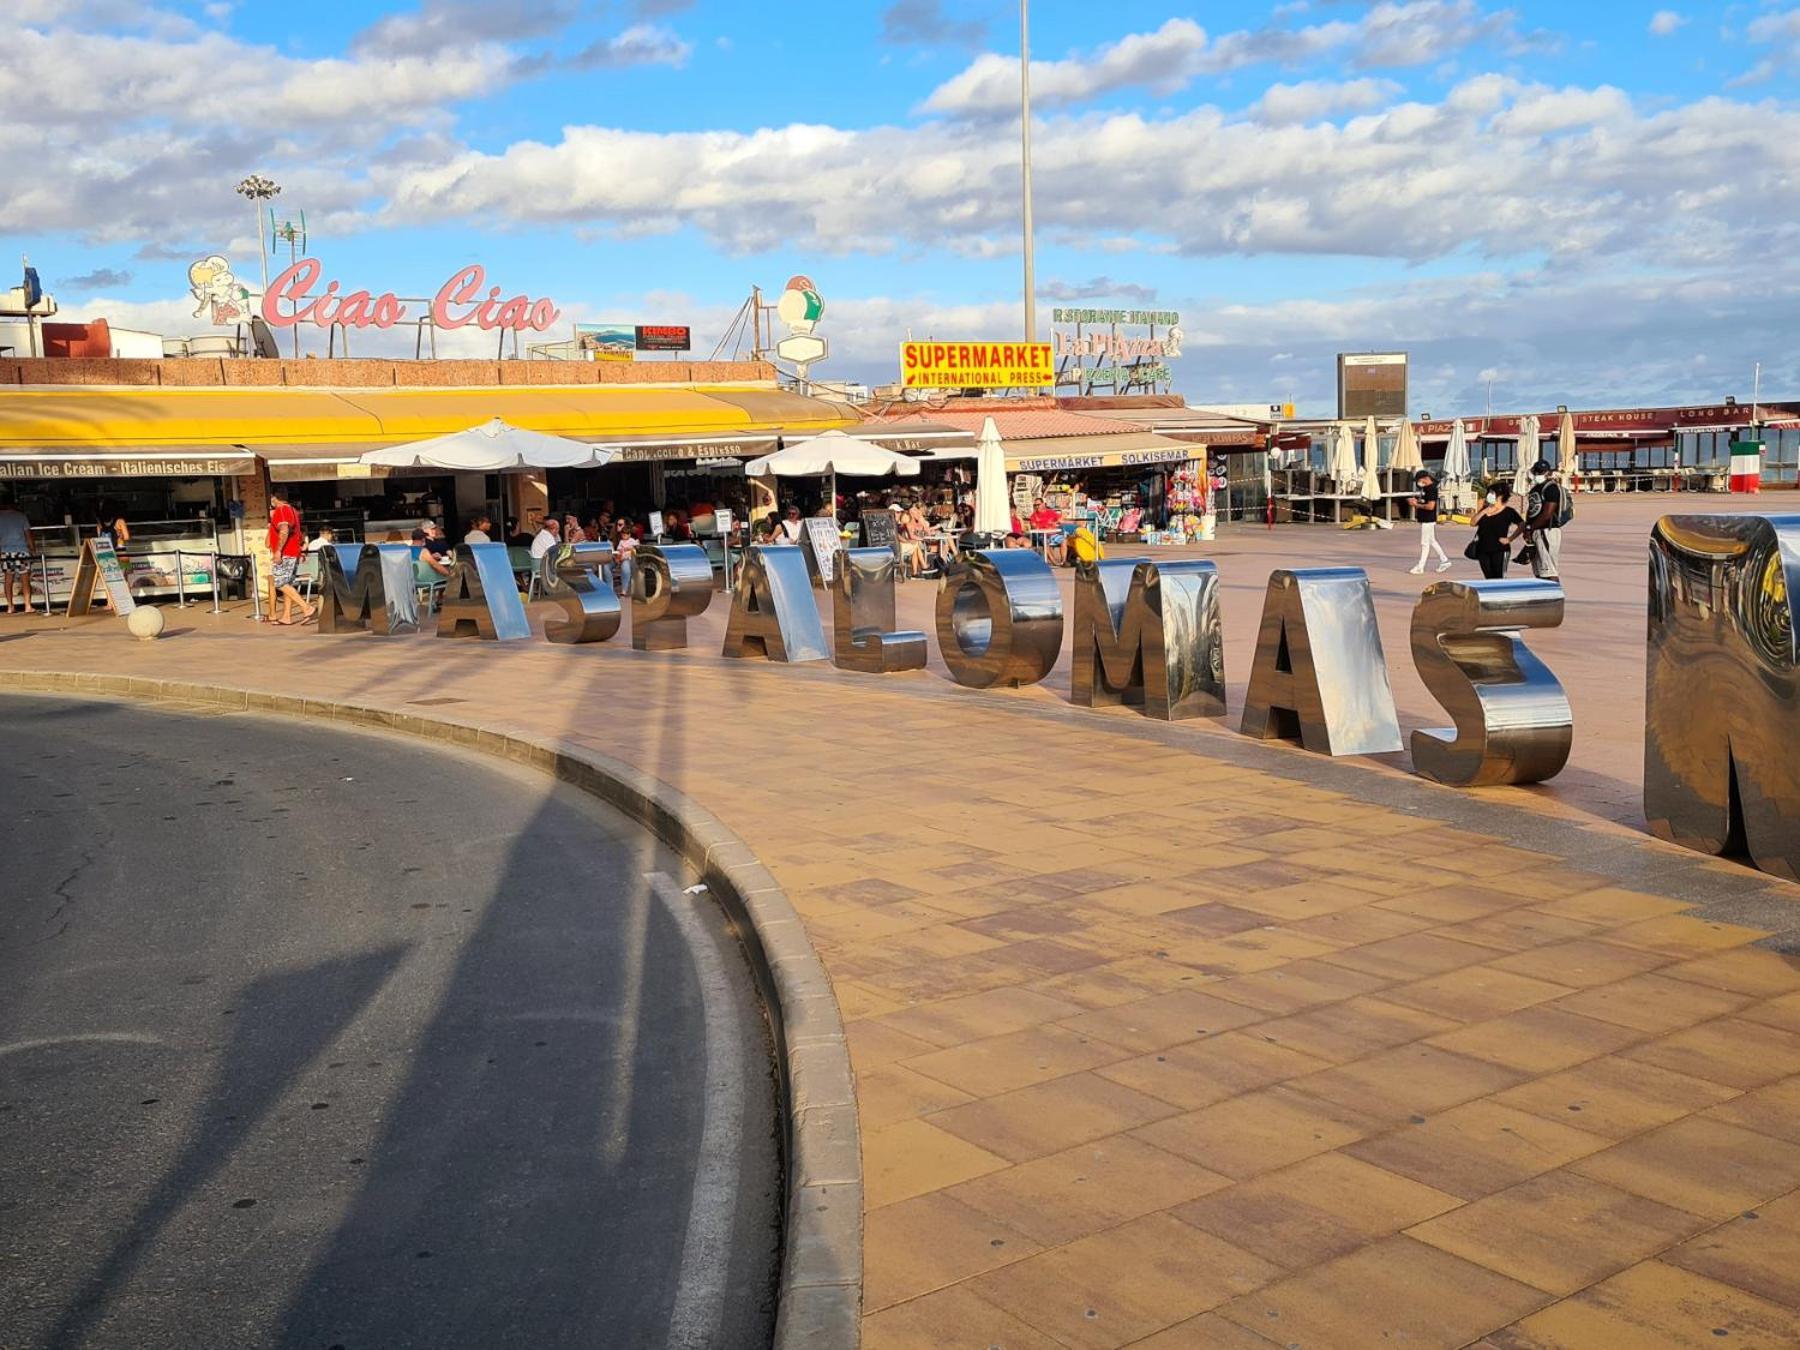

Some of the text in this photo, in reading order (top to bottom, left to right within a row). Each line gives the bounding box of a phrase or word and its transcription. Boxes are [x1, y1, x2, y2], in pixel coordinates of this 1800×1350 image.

[261, 257, 560, 331] Ciao Ciao
[643, 325, 687, 337] KIMBO
[905, 344, 1051, 369] SUPERMARKET
[918, 371, 1042, 385] INTERNATIONAL PRESS
[1582, 413, 1653, 423] STEAK HOUSE
[1680, 407, 1750, 418] LONG BAR
[687, 446, 694, 457] &
[39, 462, 59, 476] Ice
[64, 462, 106, 476] Cream
[120, 461, 202, 475] Italienisches
[207, 460, 225, 474] Eis
